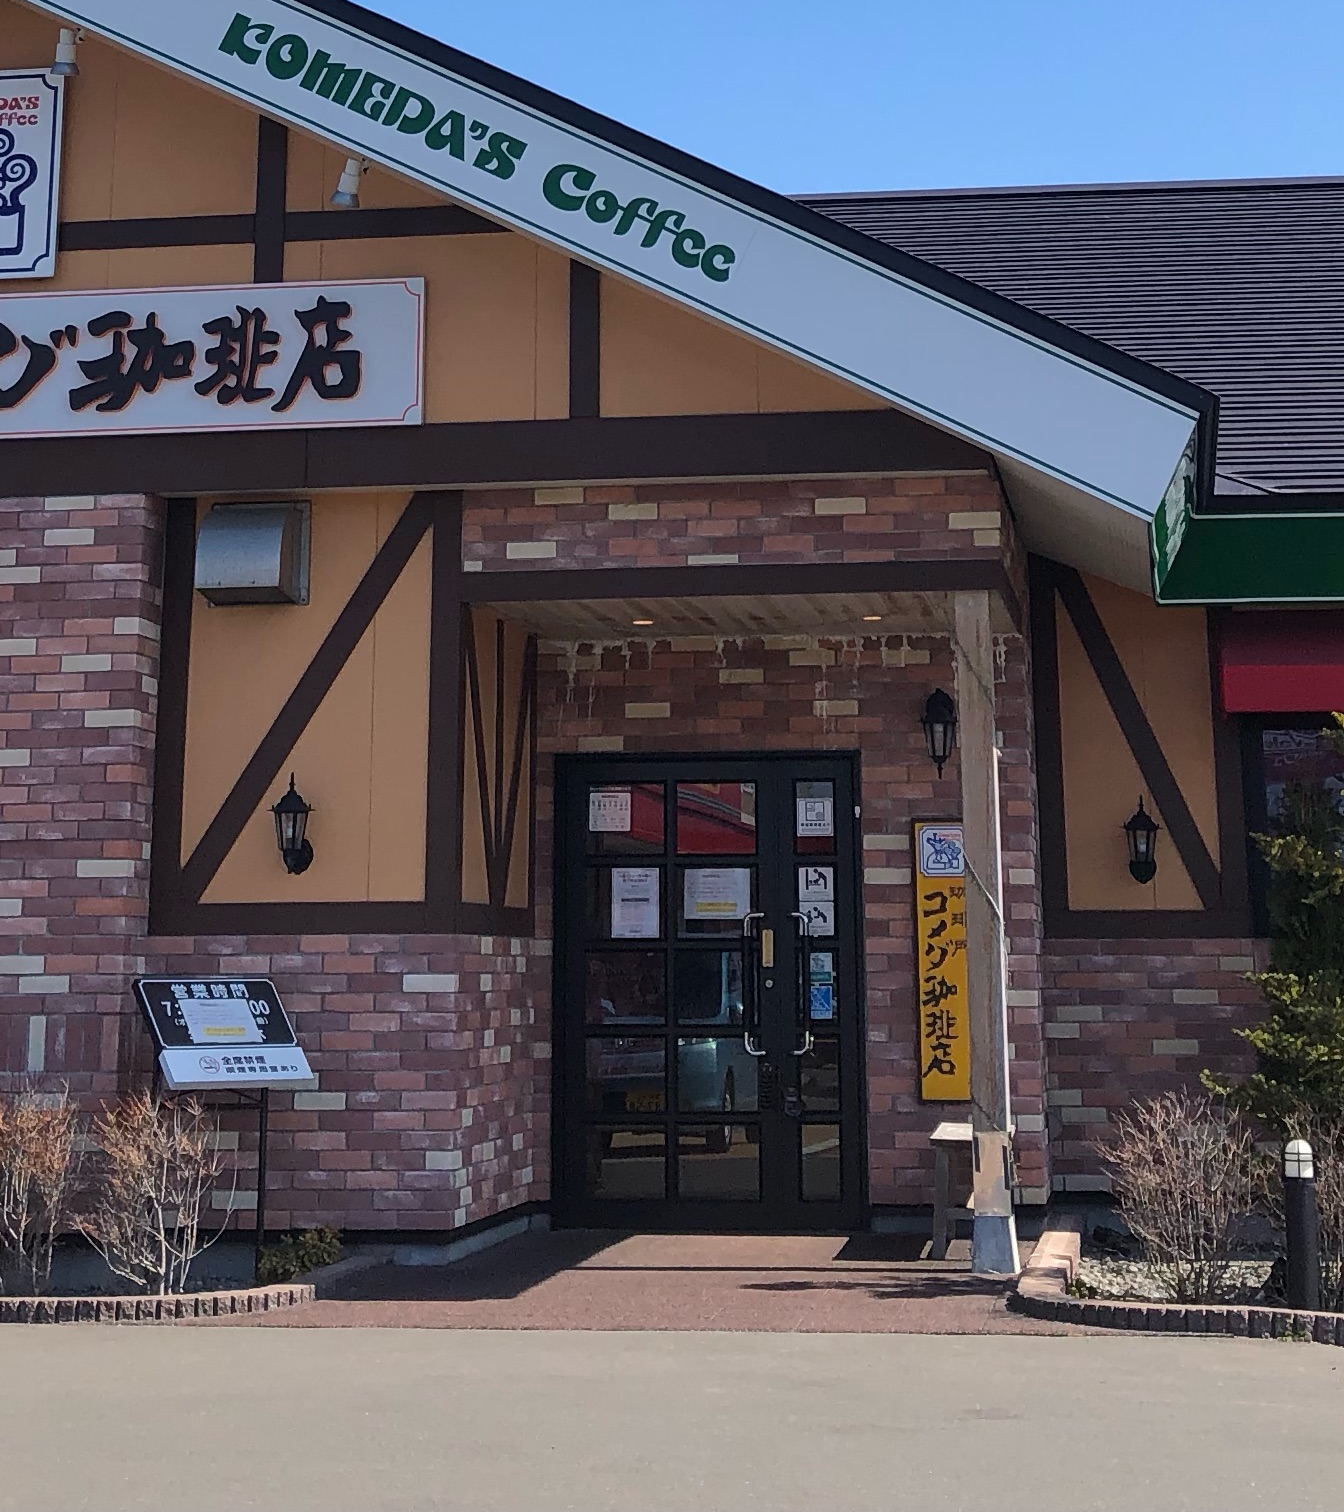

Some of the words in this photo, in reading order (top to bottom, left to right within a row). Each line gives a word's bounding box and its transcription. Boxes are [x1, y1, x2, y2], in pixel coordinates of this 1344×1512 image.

[217, 12, 529, 181] KOMEDA'S
[542, 163, 736, 283] Coffee
[170, 983, 250, 999] 営業時間
[922, 891, 959, 1078] コメダ珈琲店
